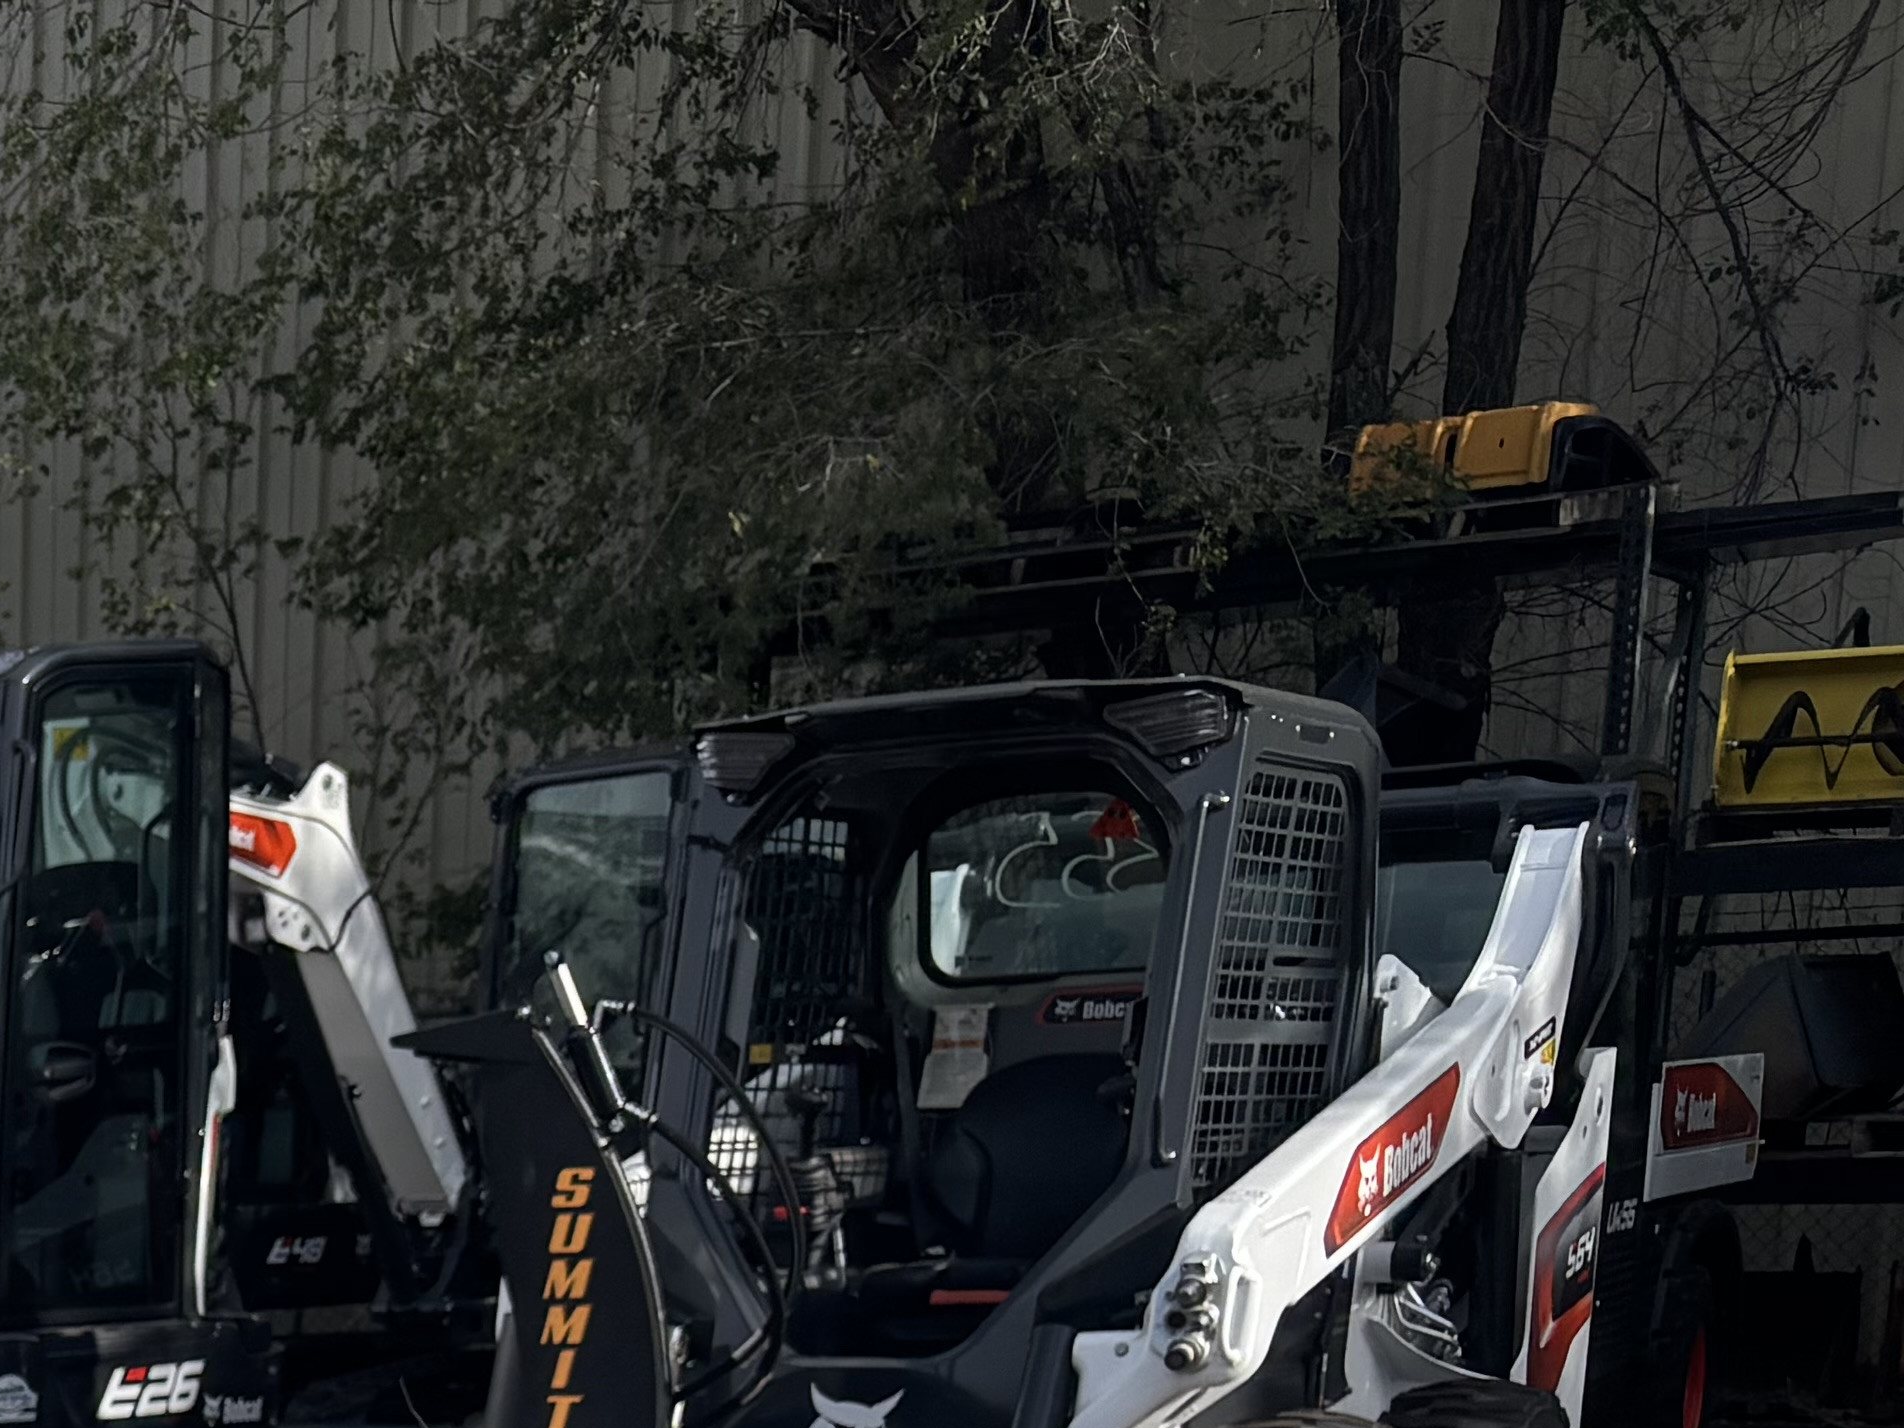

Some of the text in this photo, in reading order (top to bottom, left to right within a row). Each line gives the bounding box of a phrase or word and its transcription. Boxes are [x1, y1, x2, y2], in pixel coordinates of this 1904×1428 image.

[1083, 1000, 1126, 1020] Bobc
[1383, 1112, 1433, 1198] Bobcat
[1565, 1226, 1596, 1280] S64
[96, 1358, 206, 1420] E26
